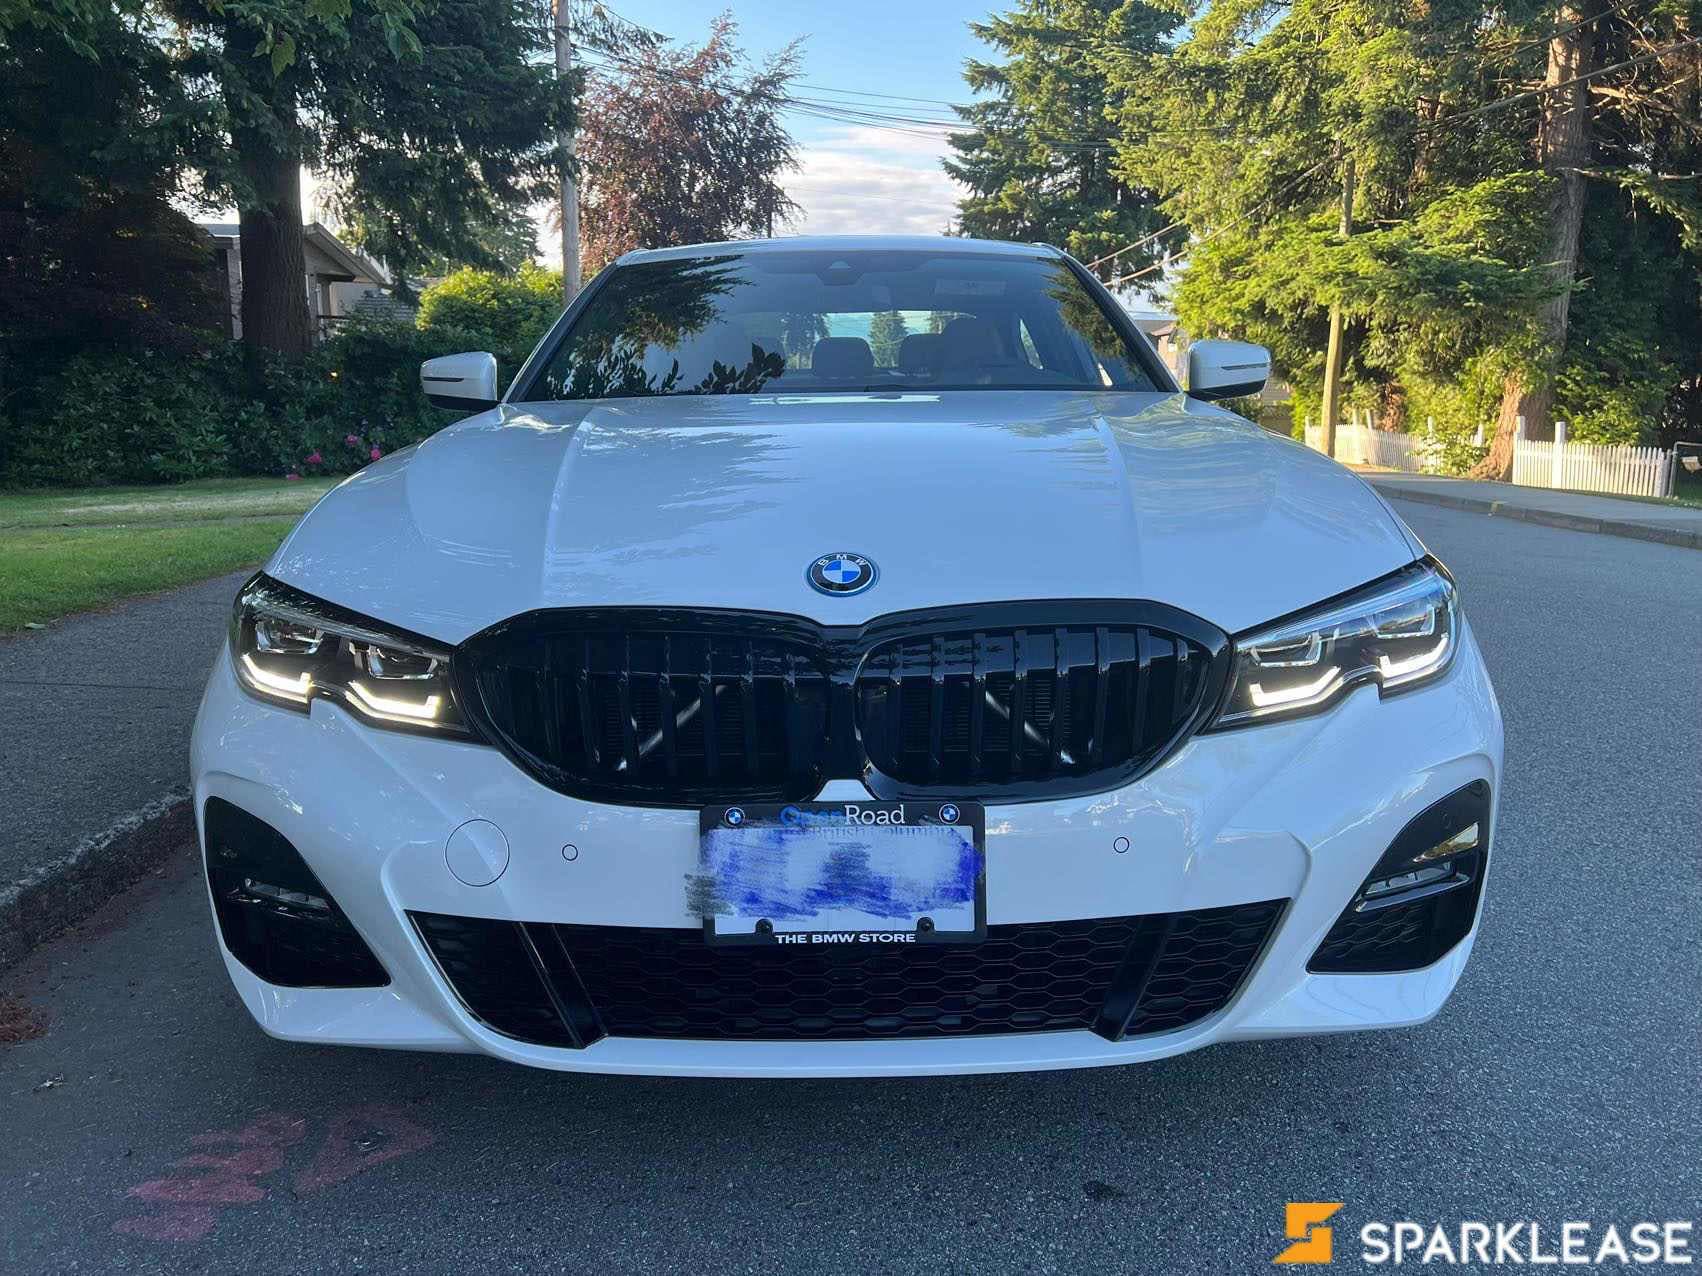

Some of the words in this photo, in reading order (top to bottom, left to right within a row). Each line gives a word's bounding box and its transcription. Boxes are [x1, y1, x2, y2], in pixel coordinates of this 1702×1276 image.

[775, 934, 807, 944] THE
[812, 934, 855, 944] BMW
[858, 933, 916, 943] STORE
